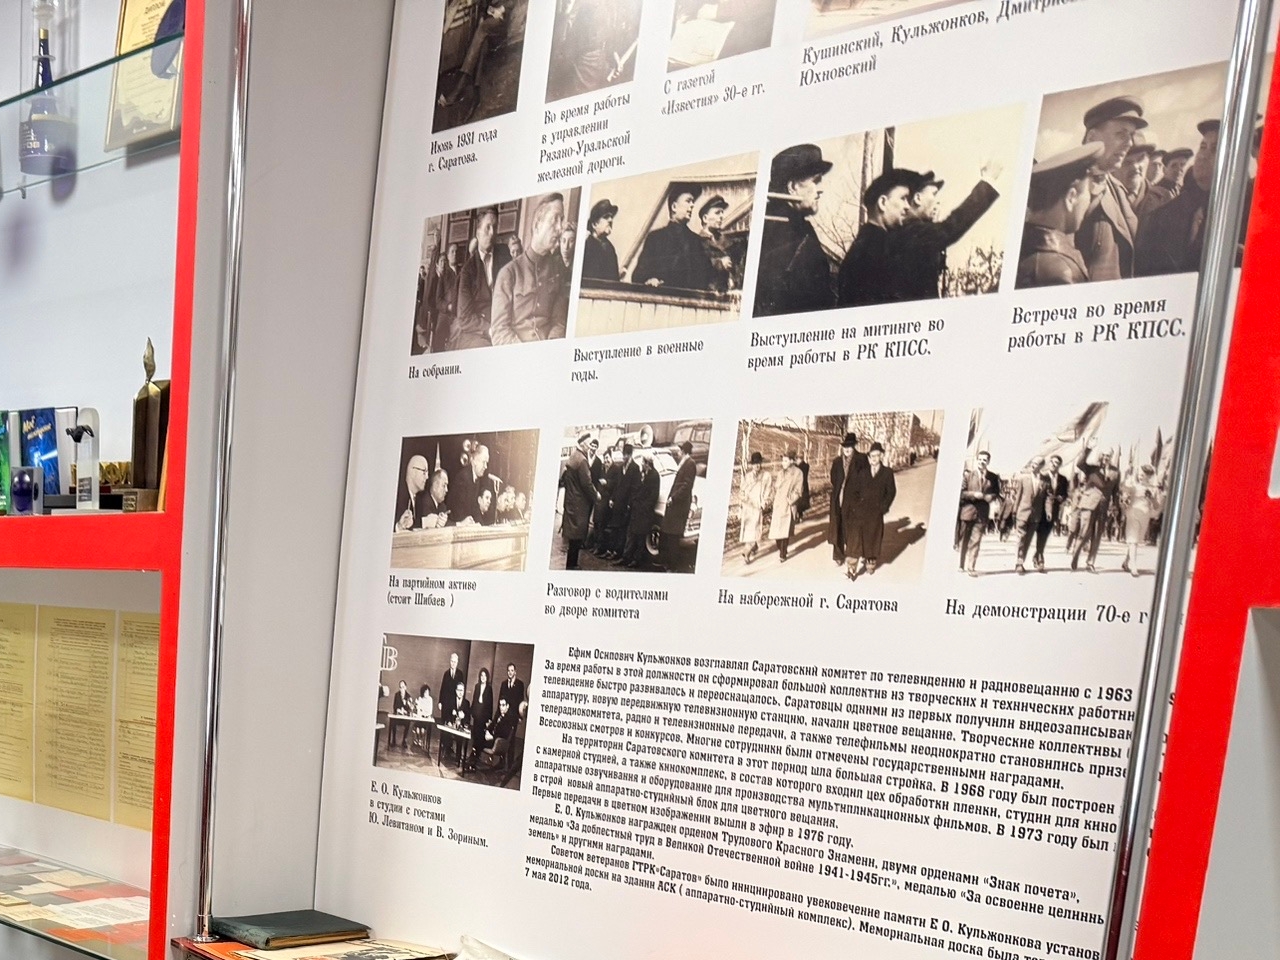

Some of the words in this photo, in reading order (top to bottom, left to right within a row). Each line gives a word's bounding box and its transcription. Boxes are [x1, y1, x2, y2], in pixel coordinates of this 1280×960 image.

[802, 31, 883, 64] Кушинский,
[890, 10, 989, 44] Кульжонков,
[995, 0, 1086, 23] Дмитри
[663, 79, 672, 95] С
[676, 68, 715, 91] газетой
[799, 54, 877, 86] Юхновский
[543, 109, 557, 125] Во
[559, 104, 590, 123] время
[592, 93, 631, 116] работы
[660, 94, 719, 115] «Известия»
[722, 85, 748, 102] 30-е
[751, 82, 765, 96] гг.
[477, 128, 498, 143] года
[540, 133, 547, 145] в
[549, 119, 609, 145] управлении
[539, 133, 631, 163] Рязано-Уральской
[427, 162, 435, 173] г.
[437, 152, 478, 171] Саратова.
[536, 160, 584, 183] железной
[586, 155, 626, 174] дороги.
[1011, 306, 1077, 326] Встреча
[1085, 304, 1105, 318] во
[1113, 299, 1167, 319] время
[750, 329, 835, 348] Выступление
[840, 326, 857, 339] на
[862, 321, 921, 337] митинге
[927, 318, 945, 332] во
[1007, 330, 1066, 352] работы
[1073, 331, 1084, 344] в
[1092, 322, 1120, 342] РК
[1126, 317, 1187, 340] КПСС.
[573, 346, 642, 363] Выступление
[645, 345, 653, 356] в
[656, 340, 704, 354] военные
[747, 355, 784, 372] время
[789, 348, 836, 369] работы
[842, 349, 850, 361] в
[856, 342, 879, 360] РК
[884, 338, 931, 358] КПСС.
[408, 365, 420, 379] На
[422, 363, 462, 379] собрании.
[570, 369, 599, 383] годы.
[388, 574, 400, 588] На
[401, 576, 445, 591] партийном
[447, 580, 477, 591] активе
[546, 582, 591, 601] Разговор
[594, 587, 601, 599] с
[604, 588, 668, 601] водителями
[544, 604, 556, 615] во
[558, 605, 588, 619] дворе
[591, 607, 640, 619] комитета
[717, 588, 734, 605] На
[739, 591, 814, 609] набережной
[819, 597, 830, 609] г.
[835, 593, 898, 613] Саратова
[945, 598, 965, 616] На
[971, 604, 1087, 623] демонстрации
[1095, 604, 1131, 623] 70-е
[1138, 611, 1148, 624] г
[568, 646, 592, 660] Ефим
[593, 648, 635, 662] Осипович
[636, 651, 692, 666] Кульжонков
[693, 657, 749, 671] возглавлял
[751, 659, 818, 676] Саратовский
[821, 667, 868, 680] комитет
[869, 671, 884, 682] по
[886, 672, 966, 688] телевидению
[969, 678, 977, 690] и
[980, 680, 1080, 698] радиовещанию
[1083, 687, 1092, 699] с
[1096, 686, 1133, 702] 1963
[370, 779, 379, 793] Е.
[380, 781, 390, 795] О.
[391, 784, 442, 805] Кульжонков
[532, 772, 539, 782] в
[539, 774, 563, 786] строй
[566, 778, 594, 791] новый
[594, 783, 694, 806] аппаратно-студийный
[695, 796, 719, 810] блок
[719, 801, 739, 813] для
[740, 804, 787, 820] цветного
[789, 812, 839, 829] вещания.
[368, 798, 375, 808] в
[376, 800, 403, 814] студии
[405, 806, 411, 815] с
[412, 807, 446, 822] гостями
[531, 785, 562, 800] Первые
[563, 792, 602, 806] передачи
[603, 798, 610, 808] в
[610, 800, 648, 814] цветном
[649, 806, 711, 824] изображении
[713, 816, 747, 830] вышли
[749, 821, 756, 832] в
[758, 821, 785, 838] эфир
[787, 827, 794, 838] в
[797, 827, 824, 842] 1976
[826, 834, 854, 850] году.
[368, 810, 380, 825] Ю.
[381, 814, 425, 834] Левитаном
[427, 826, 433, 836] и
[435, 824, 445, 839] В.
[447, 827, 489, 848] Зориным.
